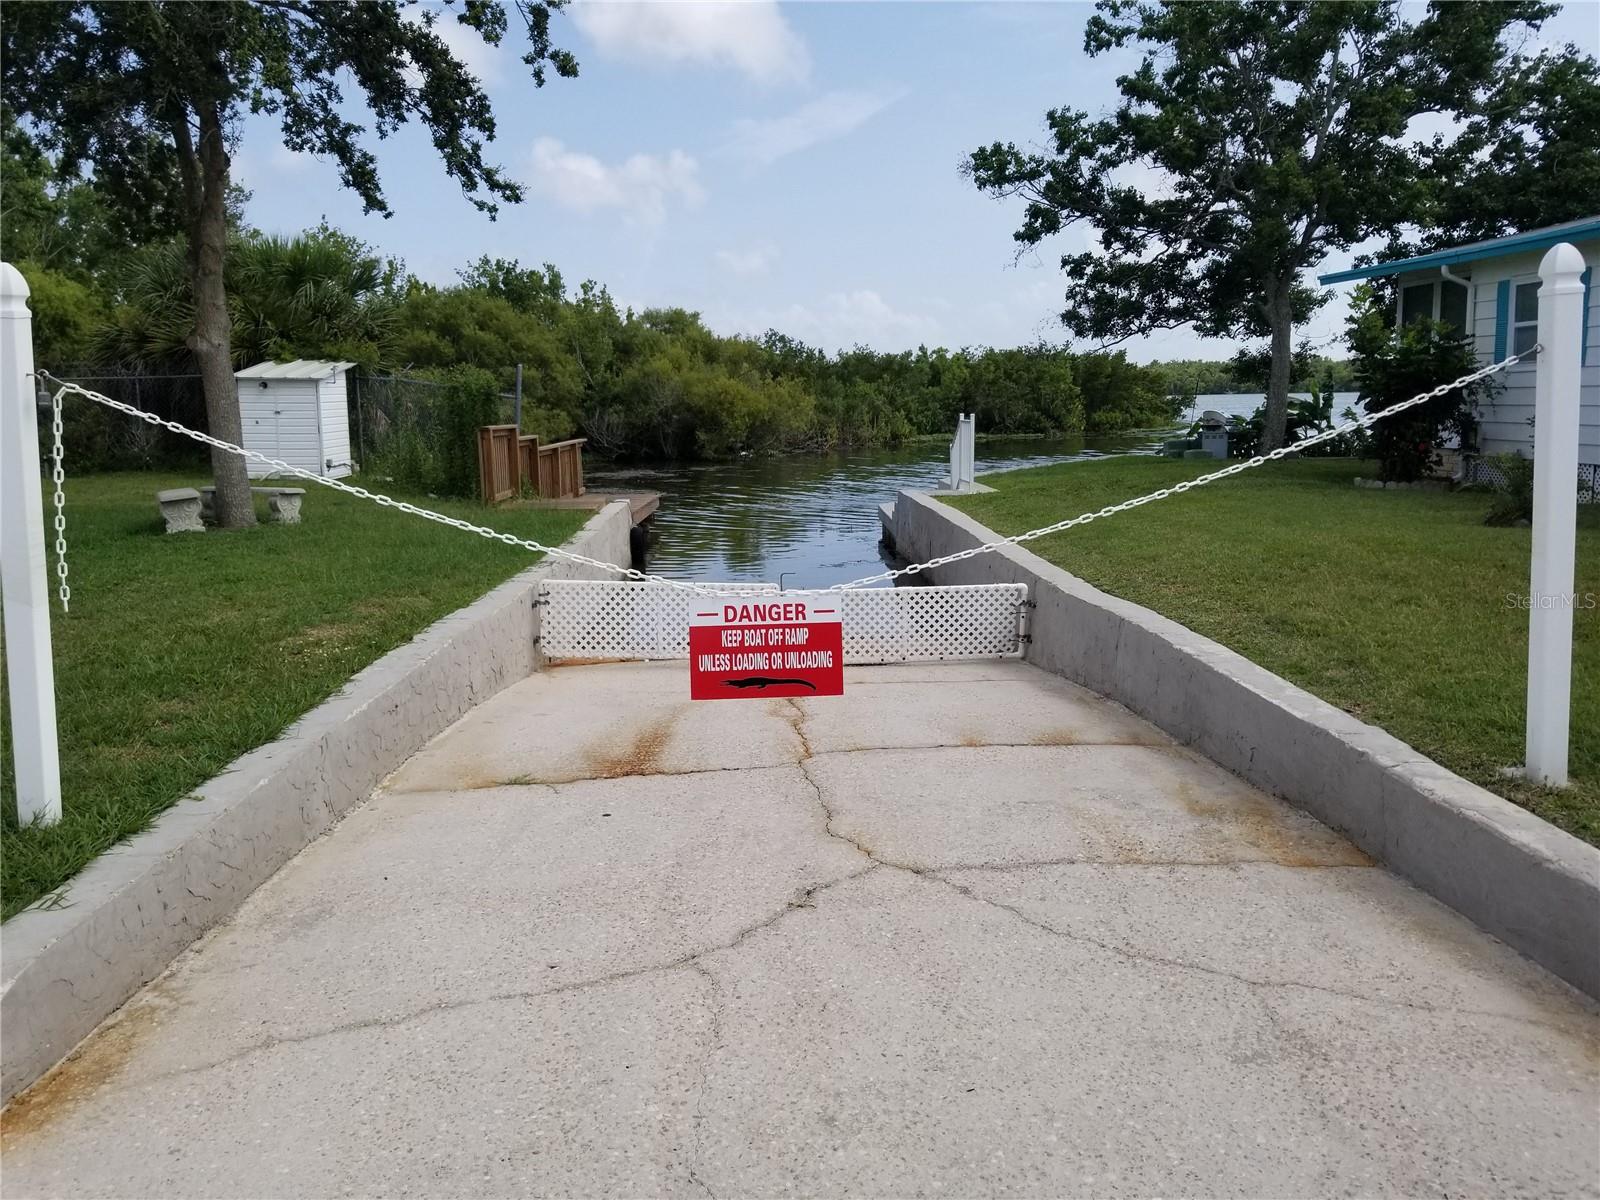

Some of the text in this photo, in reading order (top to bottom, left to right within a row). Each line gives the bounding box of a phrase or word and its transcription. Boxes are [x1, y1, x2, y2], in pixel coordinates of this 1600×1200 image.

[724, 604, 806, 622] DANGER
[721, 628, 809, 647] KEEP BOAT OFF RAMP
[699, 651, 833, 672] UNLESS LOADING OR UNLOADING
